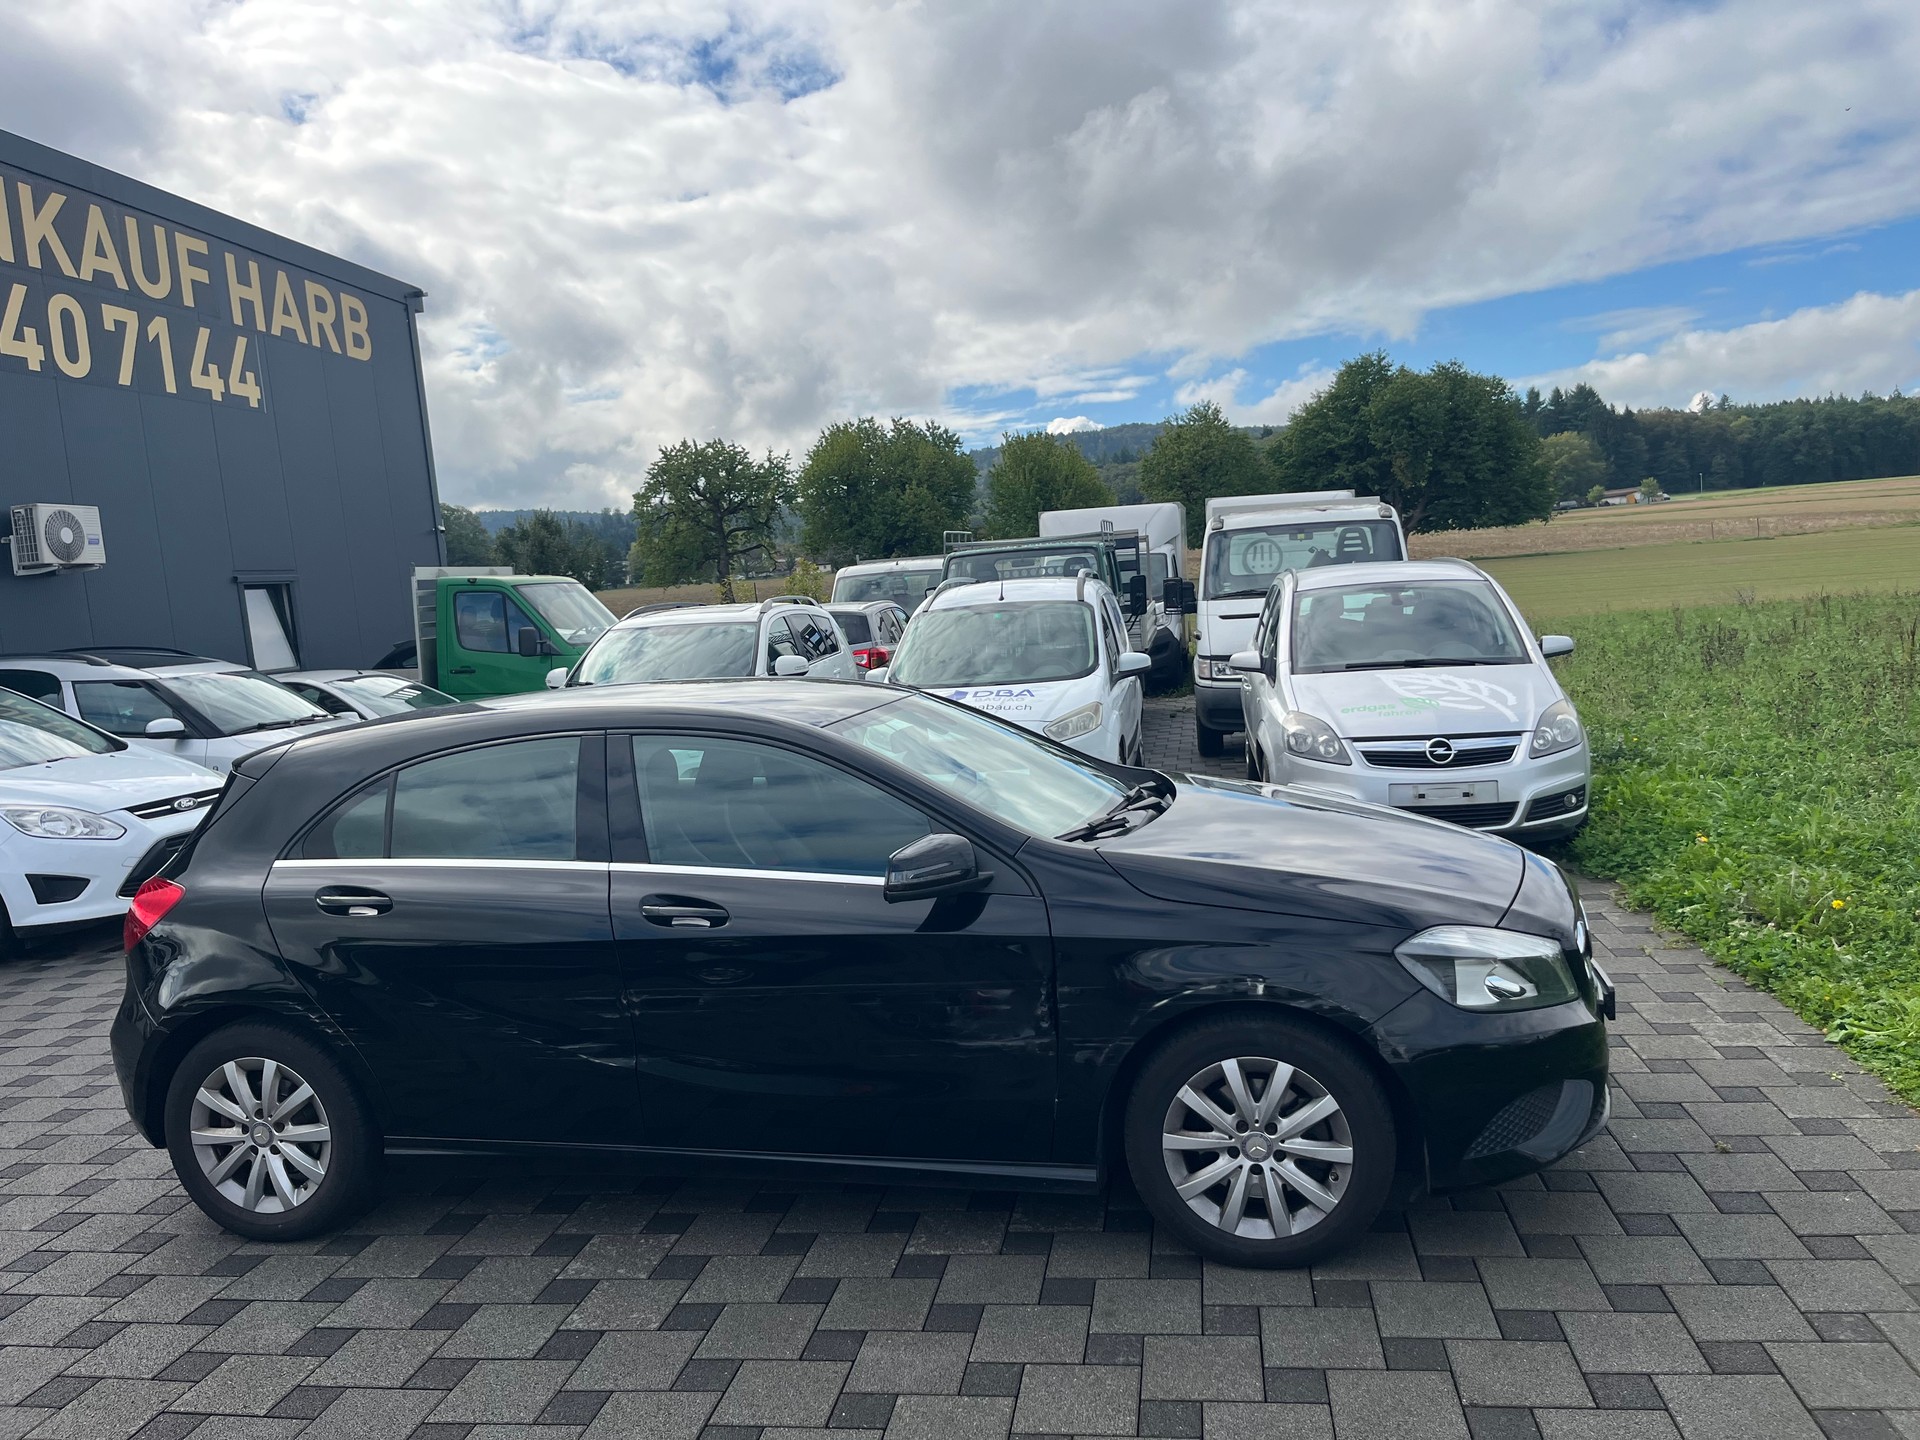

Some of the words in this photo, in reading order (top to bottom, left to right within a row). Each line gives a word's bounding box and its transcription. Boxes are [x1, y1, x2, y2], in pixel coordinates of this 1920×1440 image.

[224, 252, 372, 361] HARB
[972, 689, 1035, 698] DBA
[1341, 704, 1396, 714] erdgas
